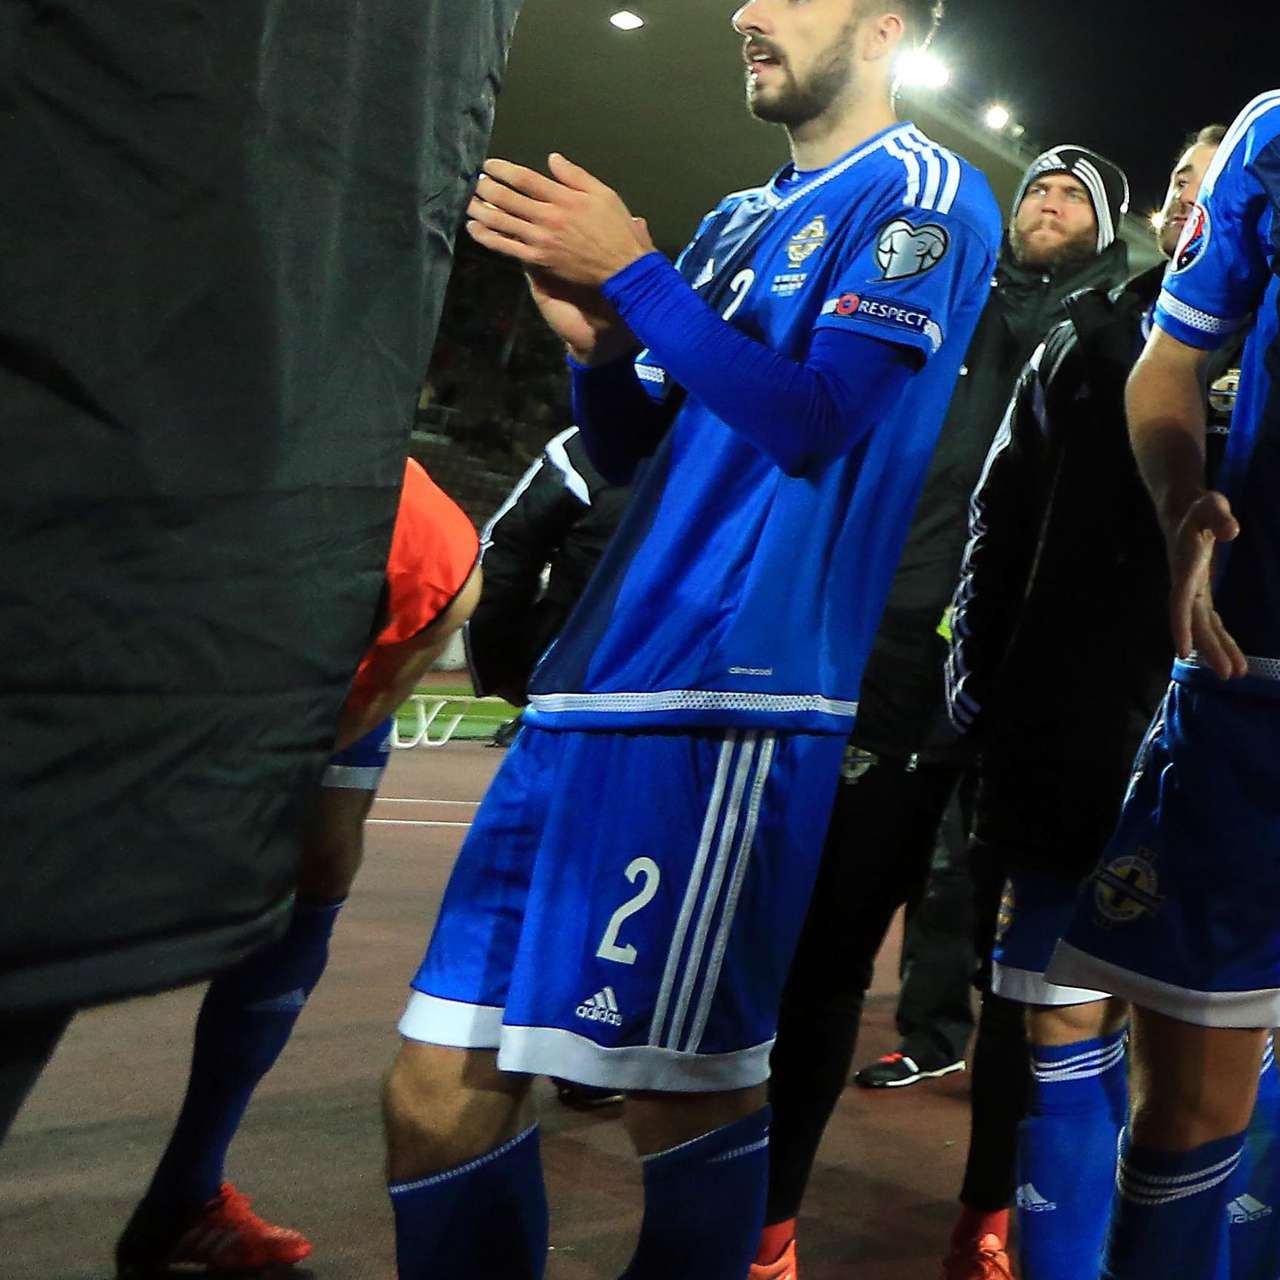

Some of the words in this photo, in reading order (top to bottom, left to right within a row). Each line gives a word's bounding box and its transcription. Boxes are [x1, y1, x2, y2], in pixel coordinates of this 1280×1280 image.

[857, 300, 928, 327] RESPECT
[595, 856, 661, 966] 2
[575, 1003, 624, 1027] adidas
